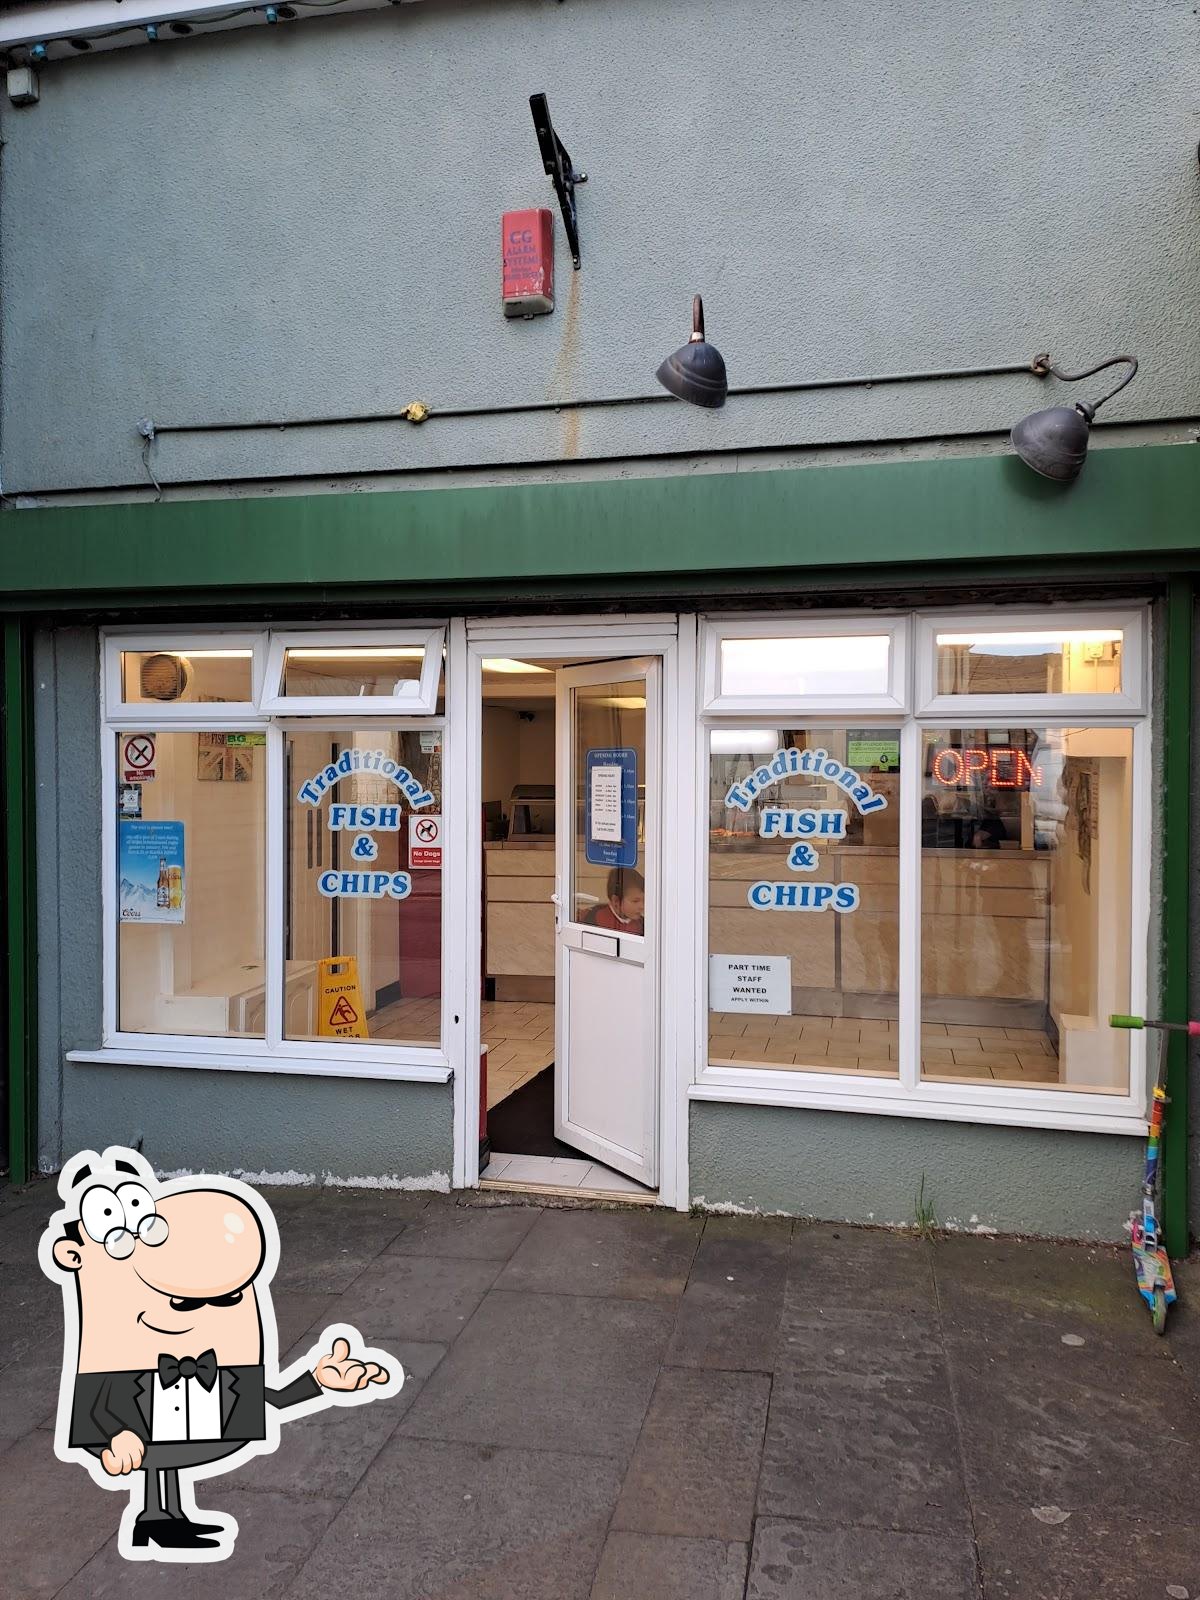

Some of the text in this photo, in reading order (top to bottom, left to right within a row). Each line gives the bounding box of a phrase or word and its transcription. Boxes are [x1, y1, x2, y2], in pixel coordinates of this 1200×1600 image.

[509, 229, 533, 244] CG
[300, 750, 434, 806] Traditional
[933, 749, 1045, 787] OPEN
[727, 748, 886, 812] Traditional
[330, 806, 399, 827] FISH
[763, 812, 844, 834] FISH
[354, 836, 375, 857] &
[424, 850, 441, 858] Dogs
[790, 844, 815, 867] &
[320, 872, 409, 895] CHIPS
[750, 884, 857, 909] CHIPS
[728, 963, 749, 971] PART
[324, 984, 356, 994] CAUTION
[737, 975, 763, 983] STAFF
[732, 986, 767, 994] WANTED
[335, 1026, 353, 1035] WET
